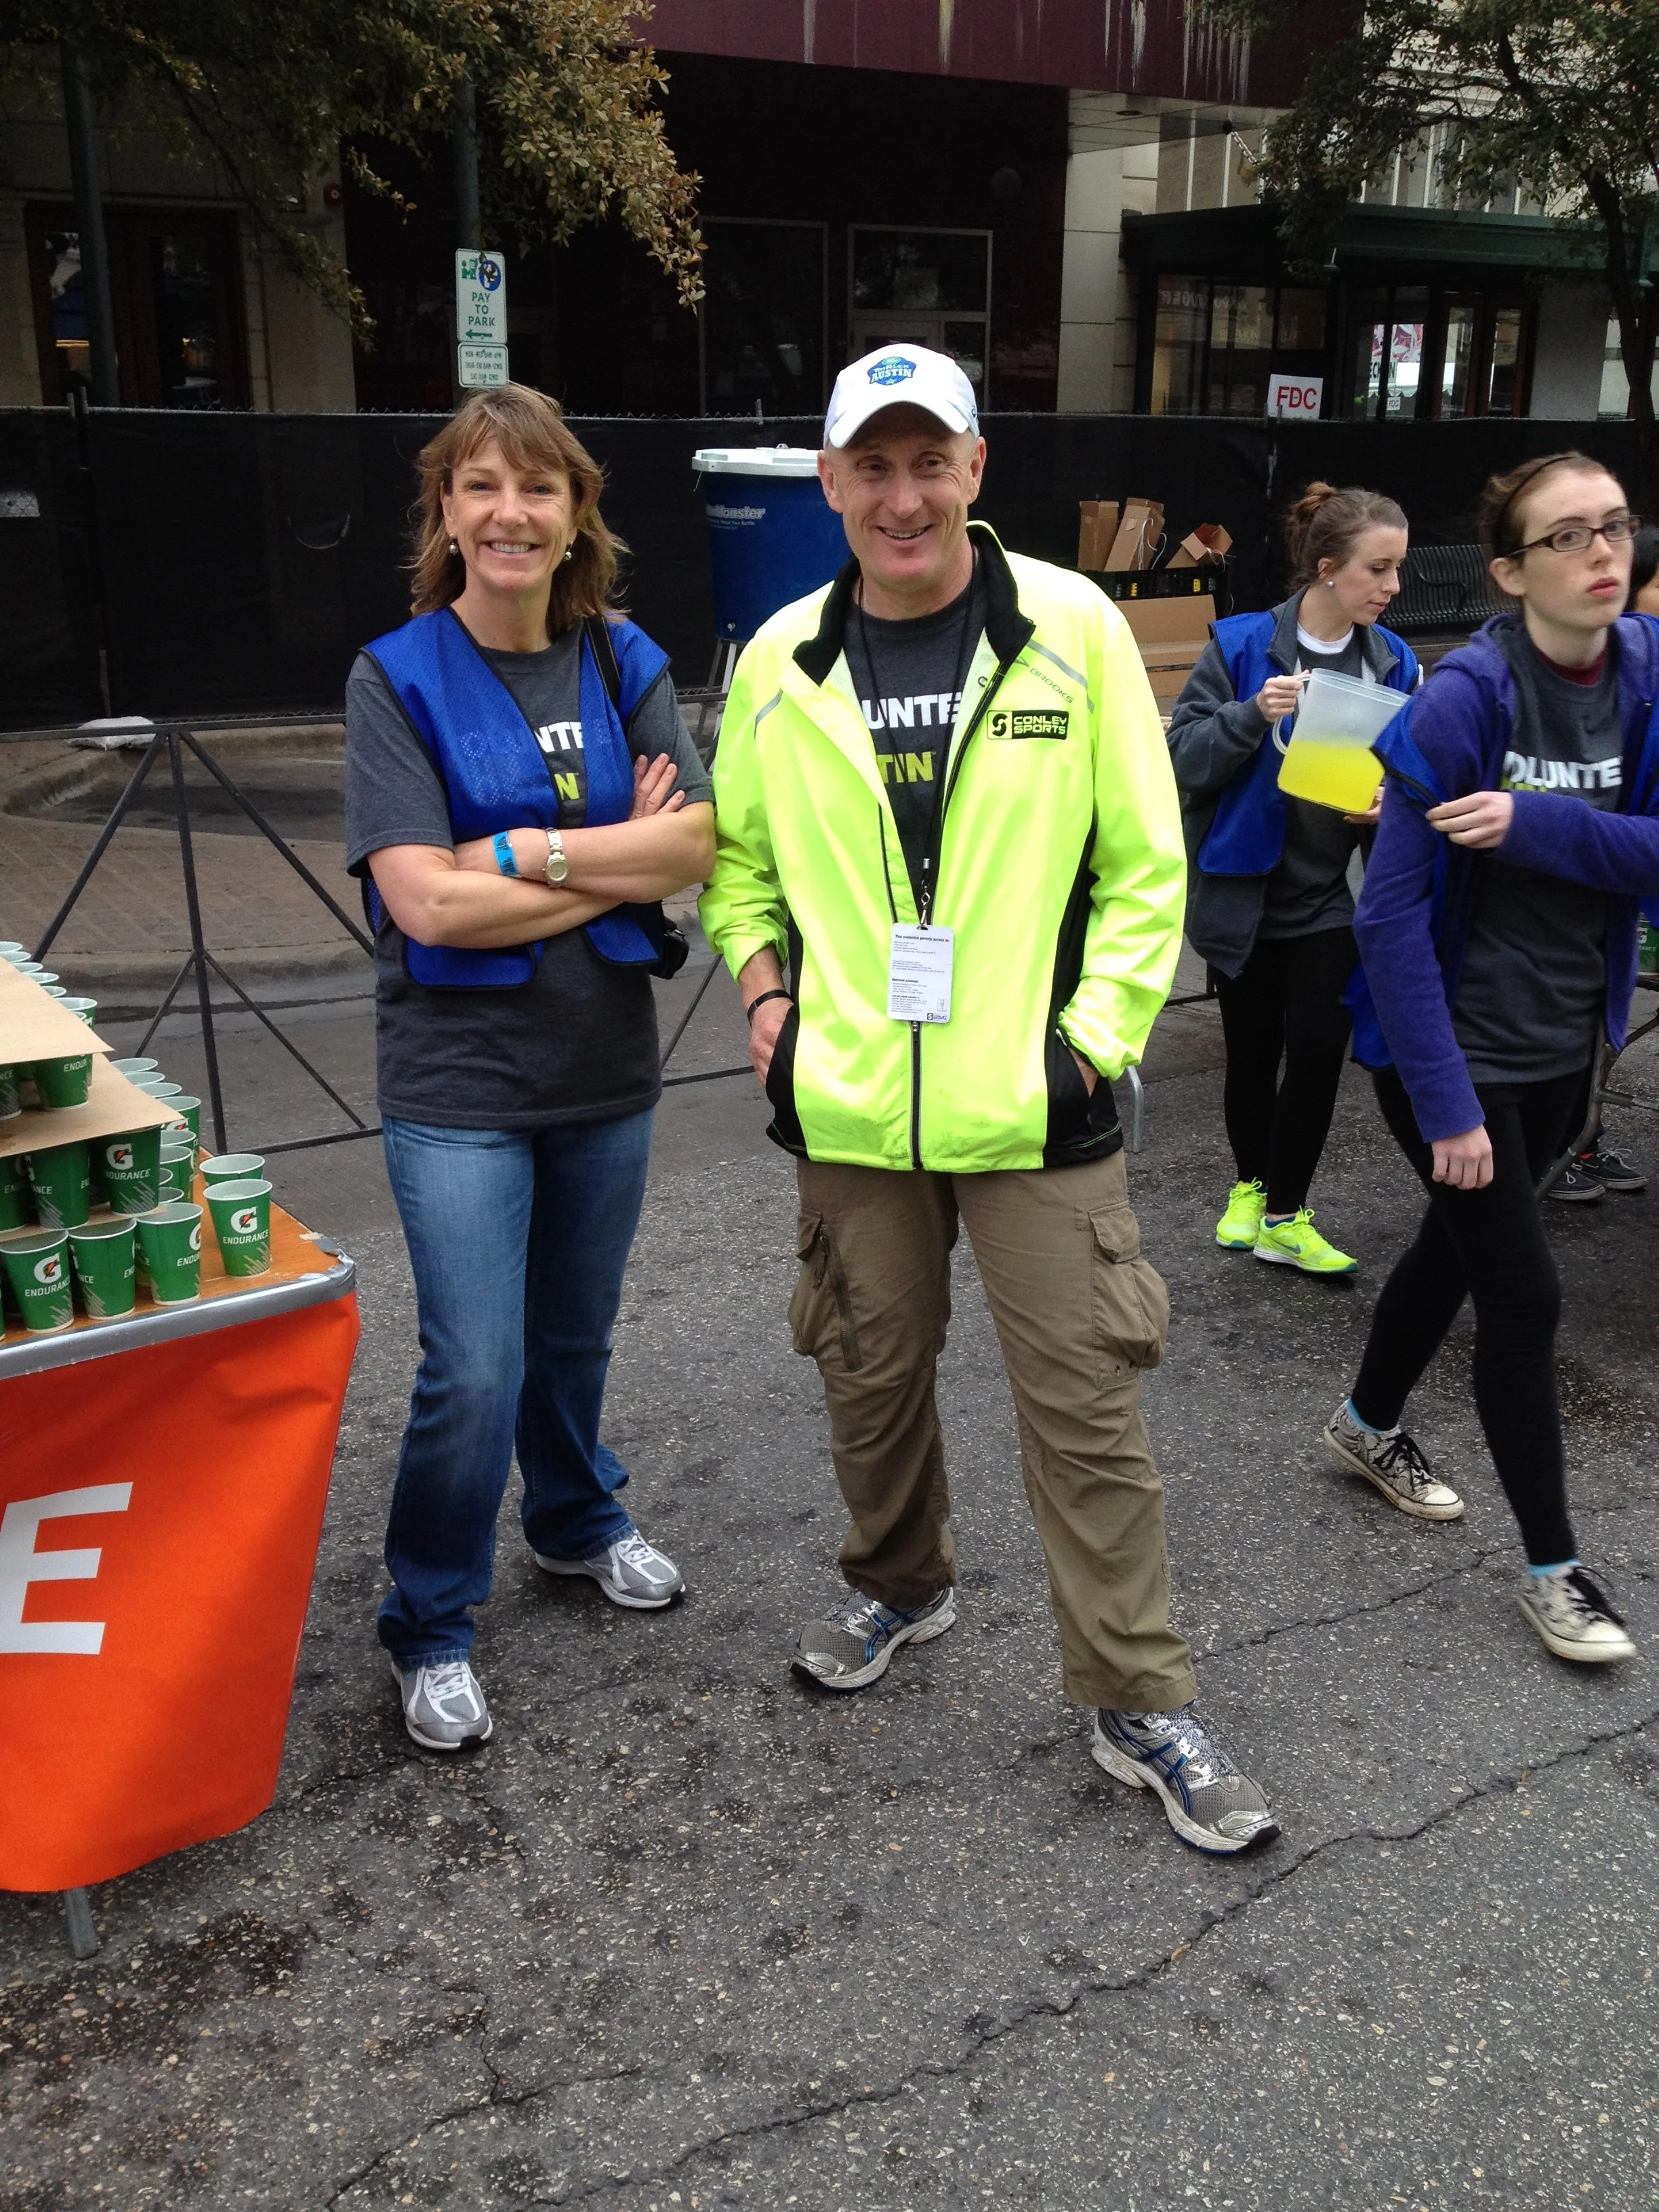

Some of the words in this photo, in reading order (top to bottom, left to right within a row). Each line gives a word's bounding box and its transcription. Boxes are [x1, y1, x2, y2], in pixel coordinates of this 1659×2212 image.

[472, 292, 491, 302] PAY
[475, 304, 489, 314] TO
[468, 316, 495, 326] PARK
[871, 368, 912, 383] AUSTIN
[1276, 386, 1317, 409] FDC
[1029, 667, 1074, 703] BROOKS
[1014, 714, 1067, 726] CONLEY
[1014, 724, 1066, 735] SPORTS
[223, 1229, 269, 1244] ENDURANCE
